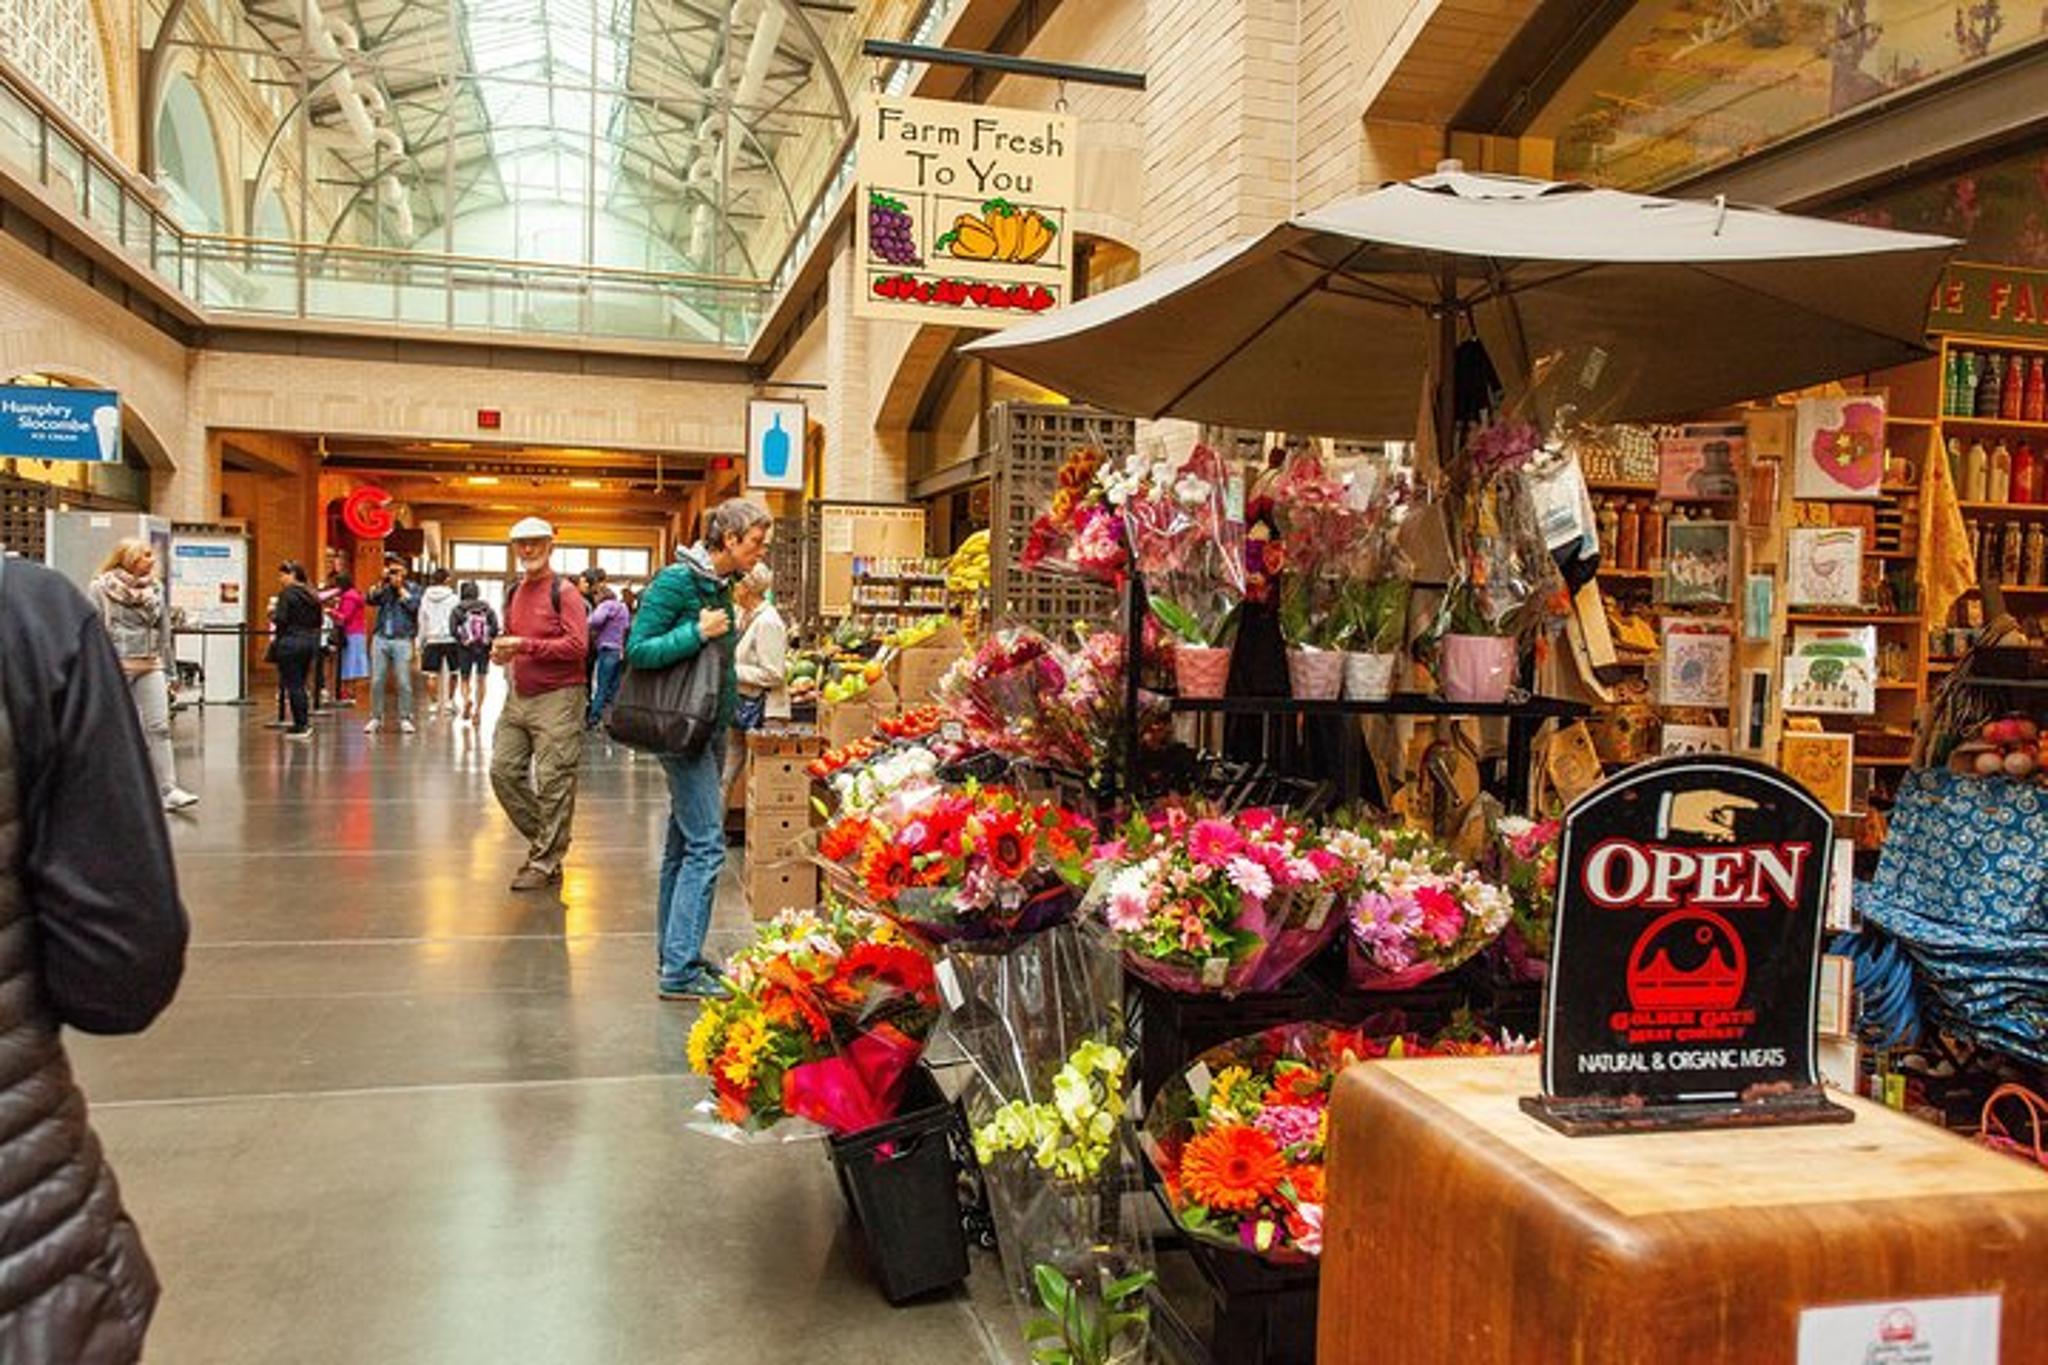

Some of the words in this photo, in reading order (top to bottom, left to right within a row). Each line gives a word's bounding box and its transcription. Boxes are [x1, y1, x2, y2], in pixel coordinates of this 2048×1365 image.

[877, 108, 960, 145] Farm
[972, 118, 1063, 156] Fresh
[905, 150, 955, 186] To
[966, 157, 1033, 192] You
[2, 400, 72, 418] Humphry
[19, 415, 90, 432] Slocombe
[344, 486, 394, 538] G
[1582, 839, 1811, 909] OPEN
[1610, 1010, 1695, 1031] GOLDEN
[1701, 1009, 1756, 1027] GATE
[1578, 1052, 1648, 1073] NATURAL
[1652, 1052, 1666, 1071] &
[1668, 1049, 1738, 1070] ORGANIC
[1740, 1048, 1786, 1067] MEATS
